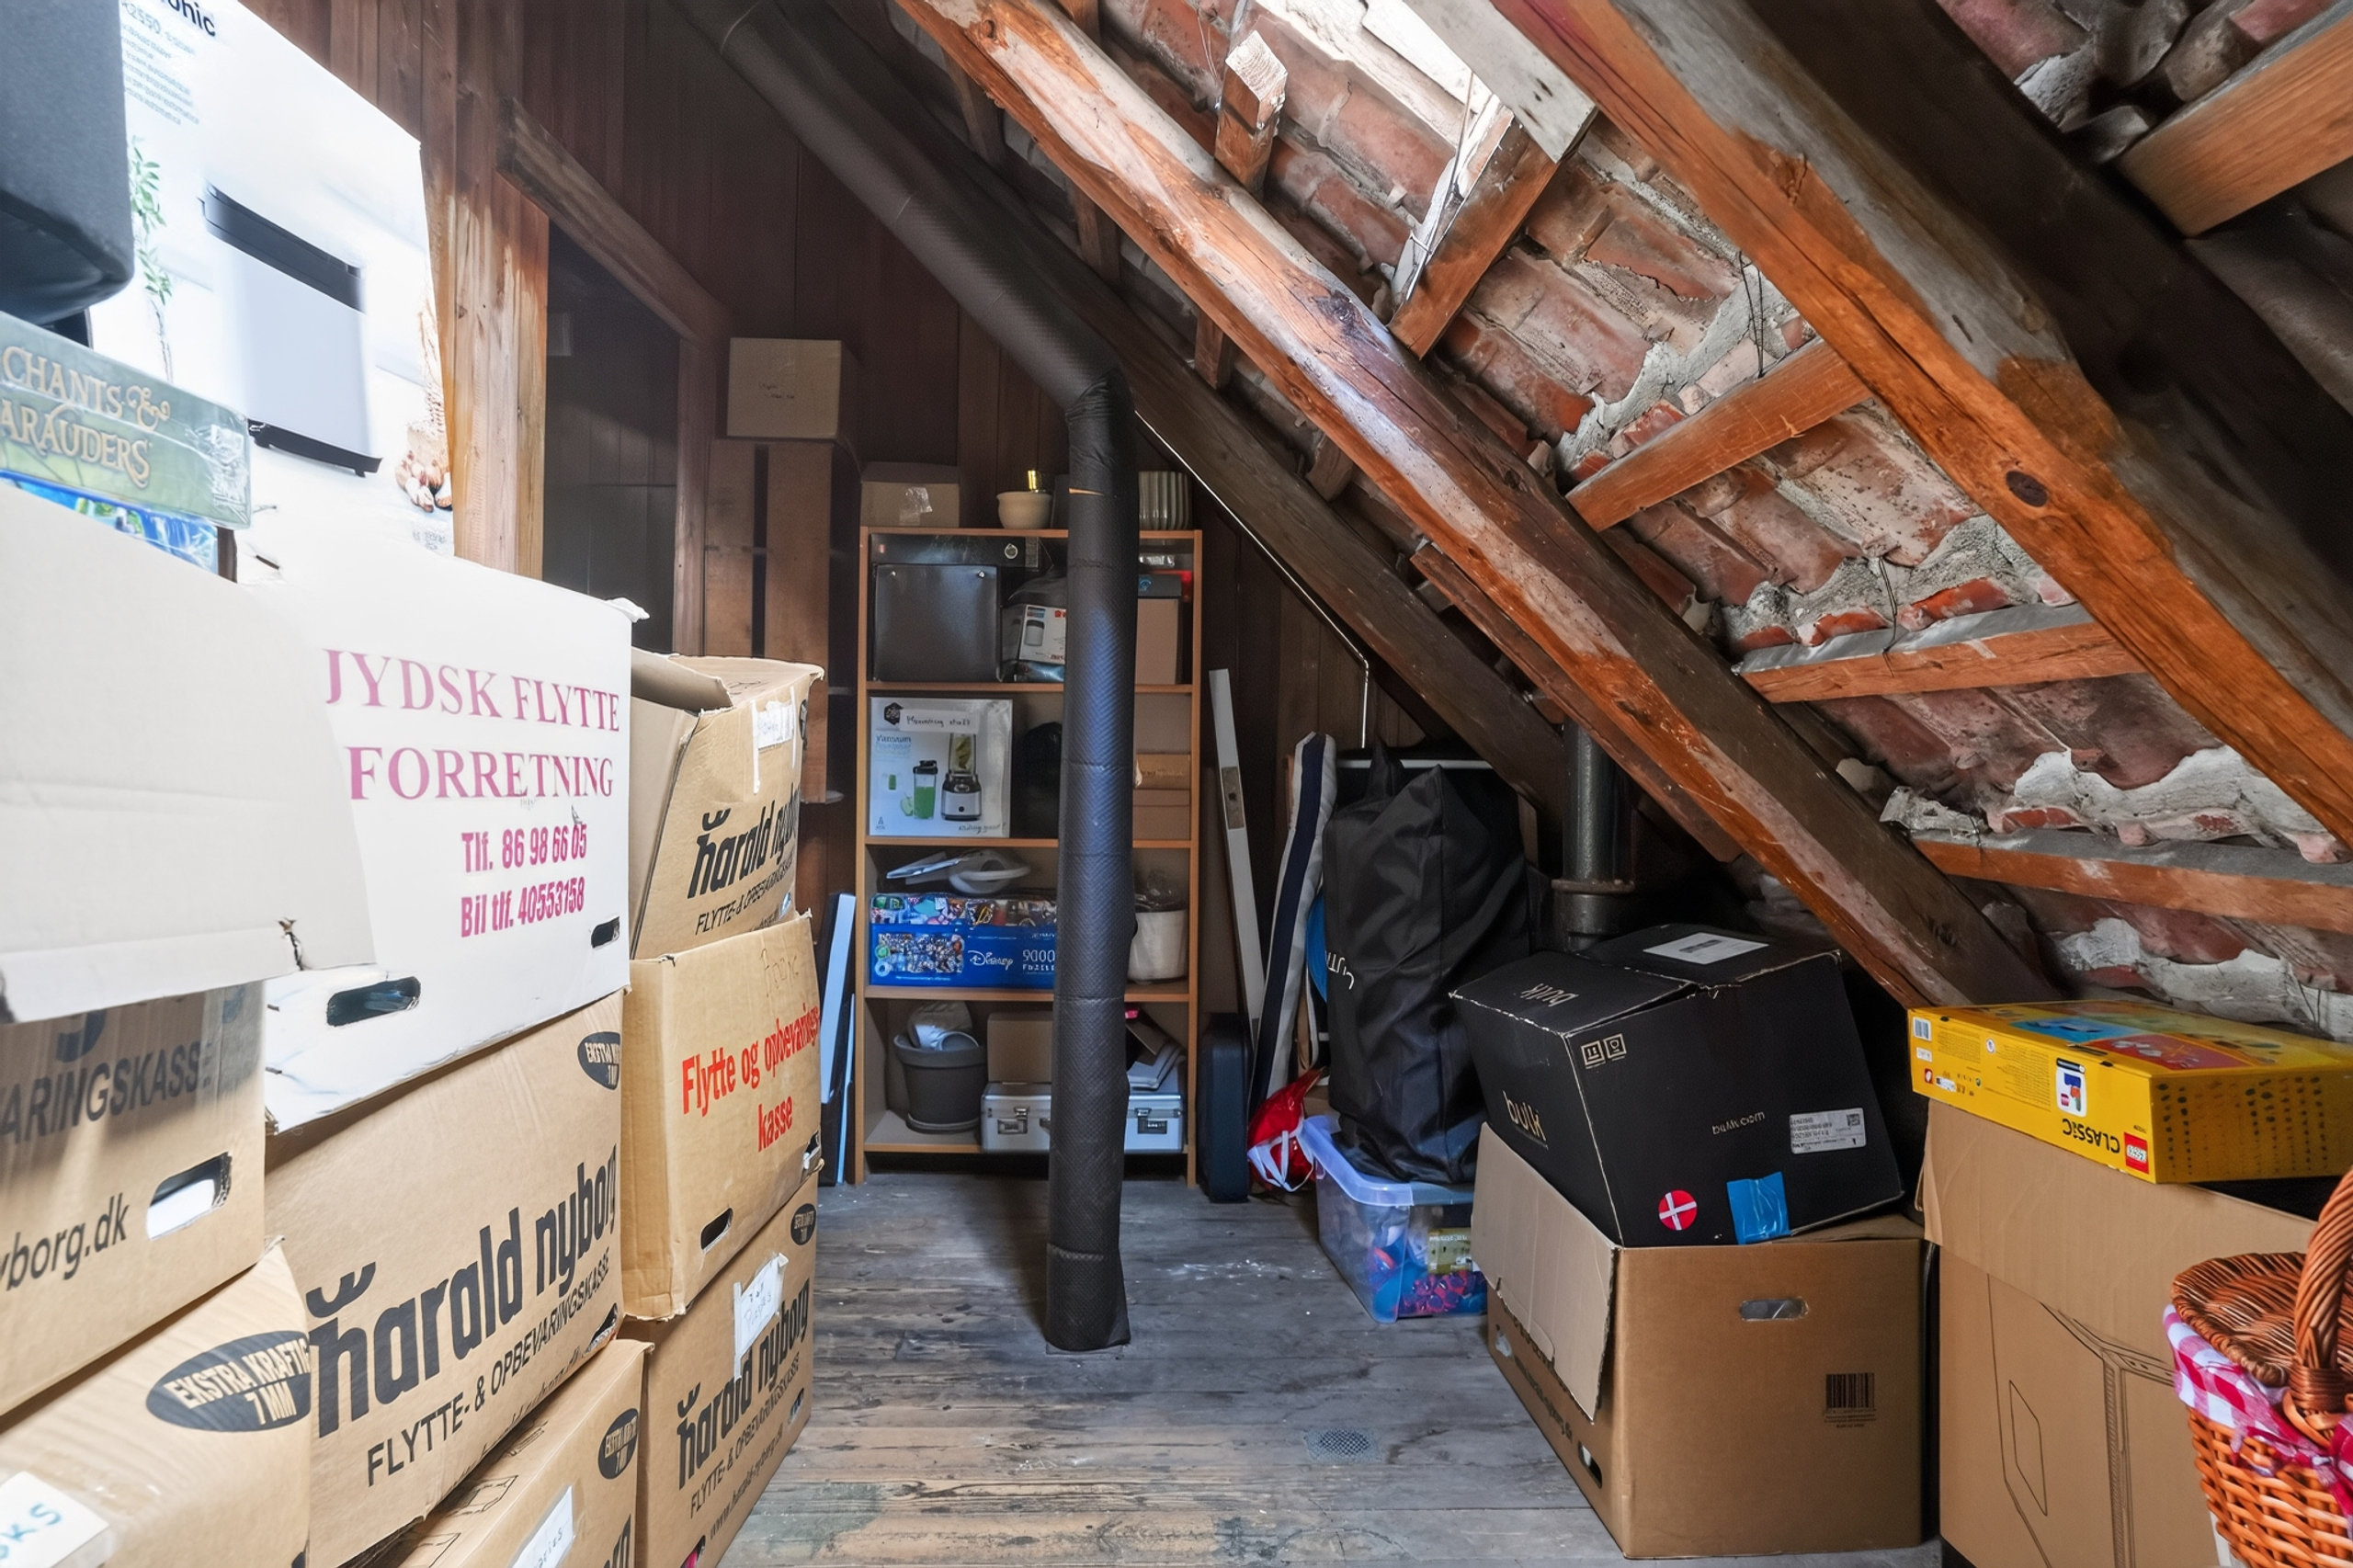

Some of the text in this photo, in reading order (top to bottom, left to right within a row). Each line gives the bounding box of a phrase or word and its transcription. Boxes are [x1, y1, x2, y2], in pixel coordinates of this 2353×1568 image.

[322, 648, 620, 733] JYDSK FLYTTE
[343, 745, 613, 801] FORRETNING
[461, 824, 588, 874] Tlf. 86 98 66 05
[688, 799, 776, 900] harald
[460, 876, 585, 938] Bil tlf. 40553158
[968, 949, 1056, 971] Disney 9000
[682, 1047, 736, 1119] Flytte
[741, 1040, 760, 1090] og
[758, 1096, 793, 1153] kasse
[1502, 1089, 1547, 1142] bulk
[1711, 1110, 1766, 1135] bulk.com
[308, 1206, 523, 1439] harald
[163, 1361, 258, 1410] EKSTRA
